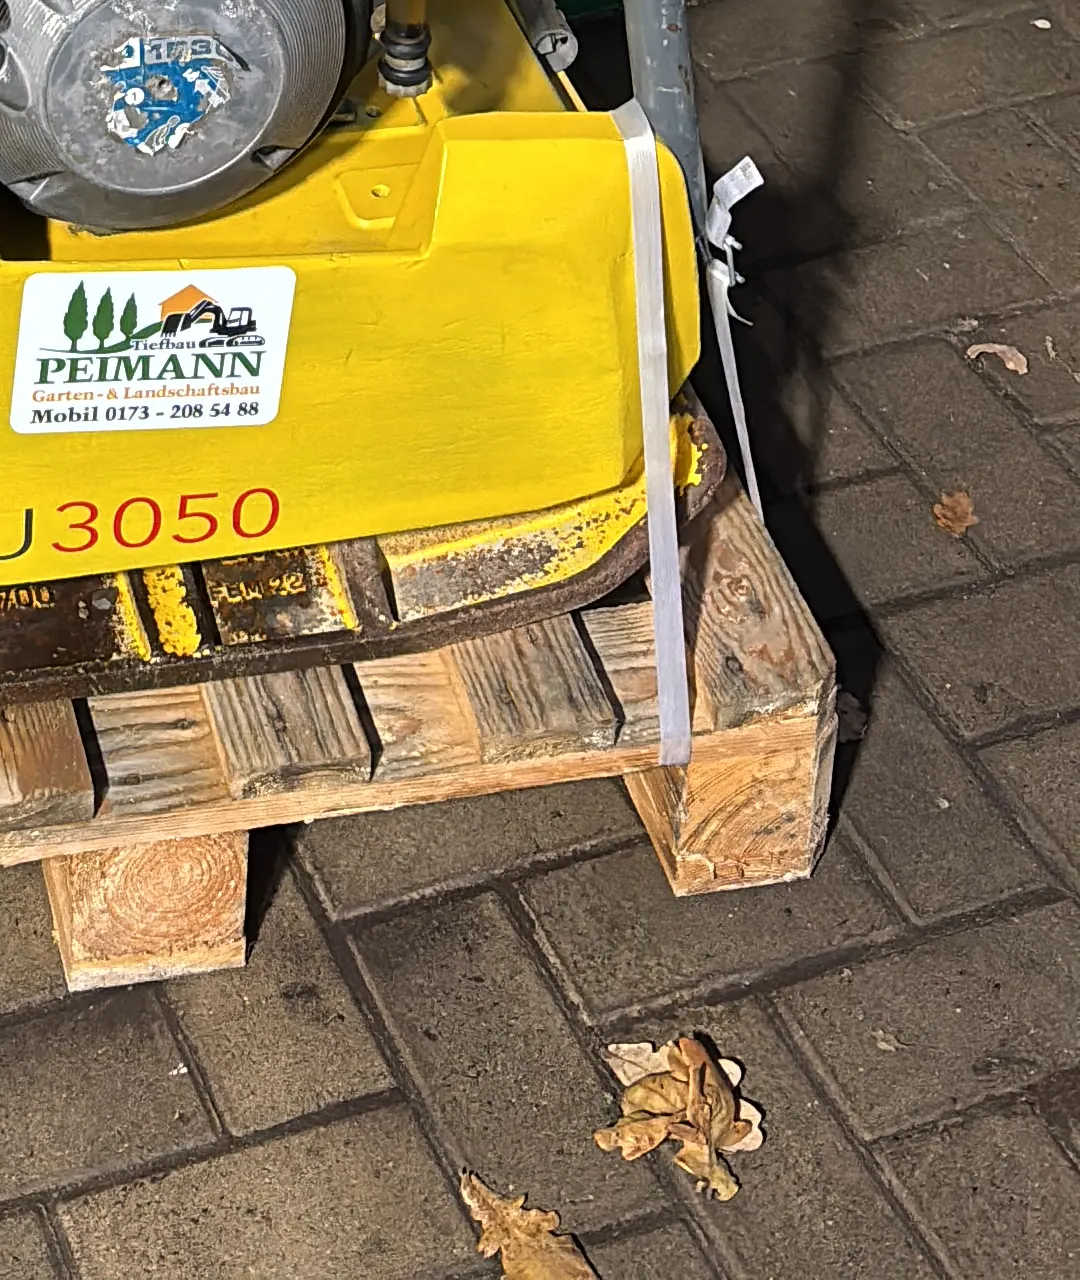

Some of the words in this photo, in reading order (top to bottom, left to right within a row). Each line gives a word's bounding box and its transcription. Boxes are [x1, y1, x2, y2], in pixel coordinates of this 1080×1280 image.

[131, 338, 196, 351] Tiefbau
[34, 351, 267, 384] PEIMANN
[106, 388, 118, 400] &
[123, 382, 260, 400] Landschaftsbau
[30, 406, 98, 424] Mobil
[105, 405, 149, 421] 0173
[170, 403, 204, 419] 208
[209, 402, 231, 417] 54
[237, 401, 259, 416] 88
